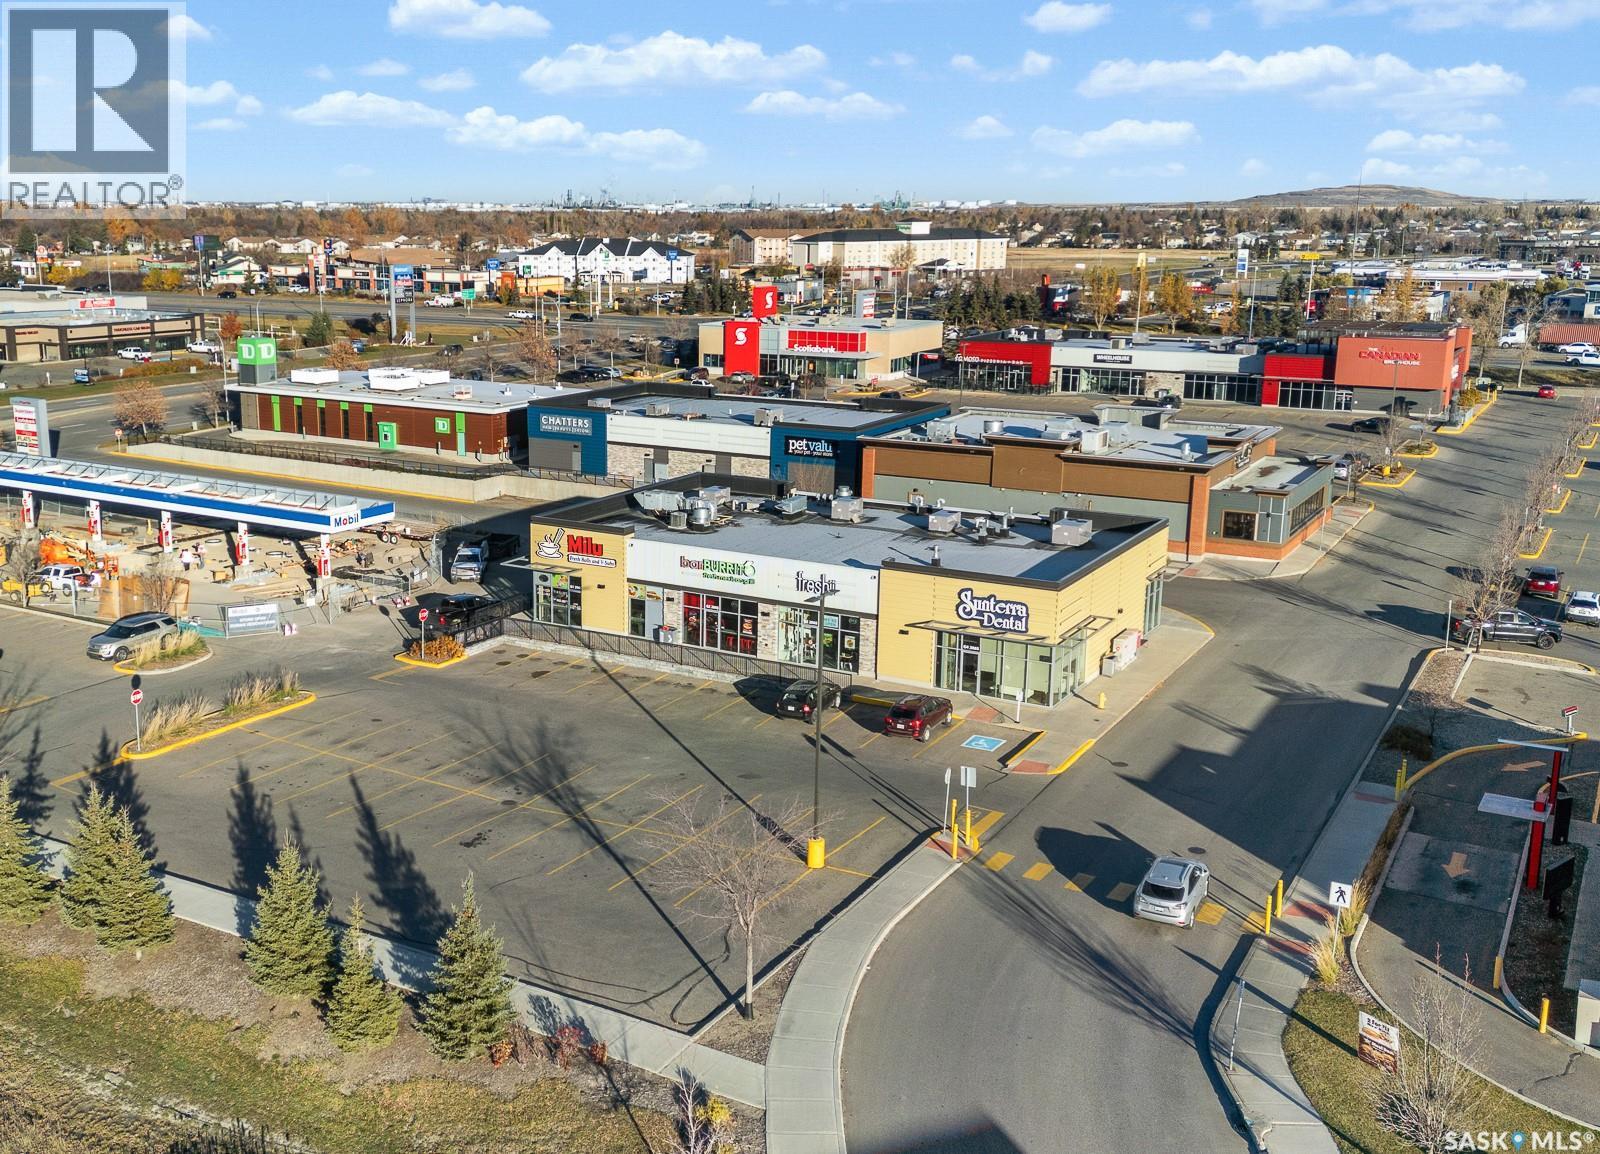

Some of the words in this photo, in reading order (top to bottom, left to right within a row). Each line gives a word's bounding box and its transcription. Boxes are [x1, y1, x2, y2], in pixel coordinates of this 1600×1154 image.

[240, 343, 256, 359] TD
[257, 343, 275, 359] TD
[793, 344, 836, 353] Scotiabank
[1096, 354, 1131, 362] WHEELHOUSE
[1359, 351, 1421, 361] CANADIAN
[436, 420, 448, 431] TD
[541, 415, 589, 428] CHATTERS
[335, 513, 359, 527] Mobil
[567, 534, 604, 556] Milu
[957, 590, 1028, 619] Sunterra
[982, 612, 1027, 631] Dental
